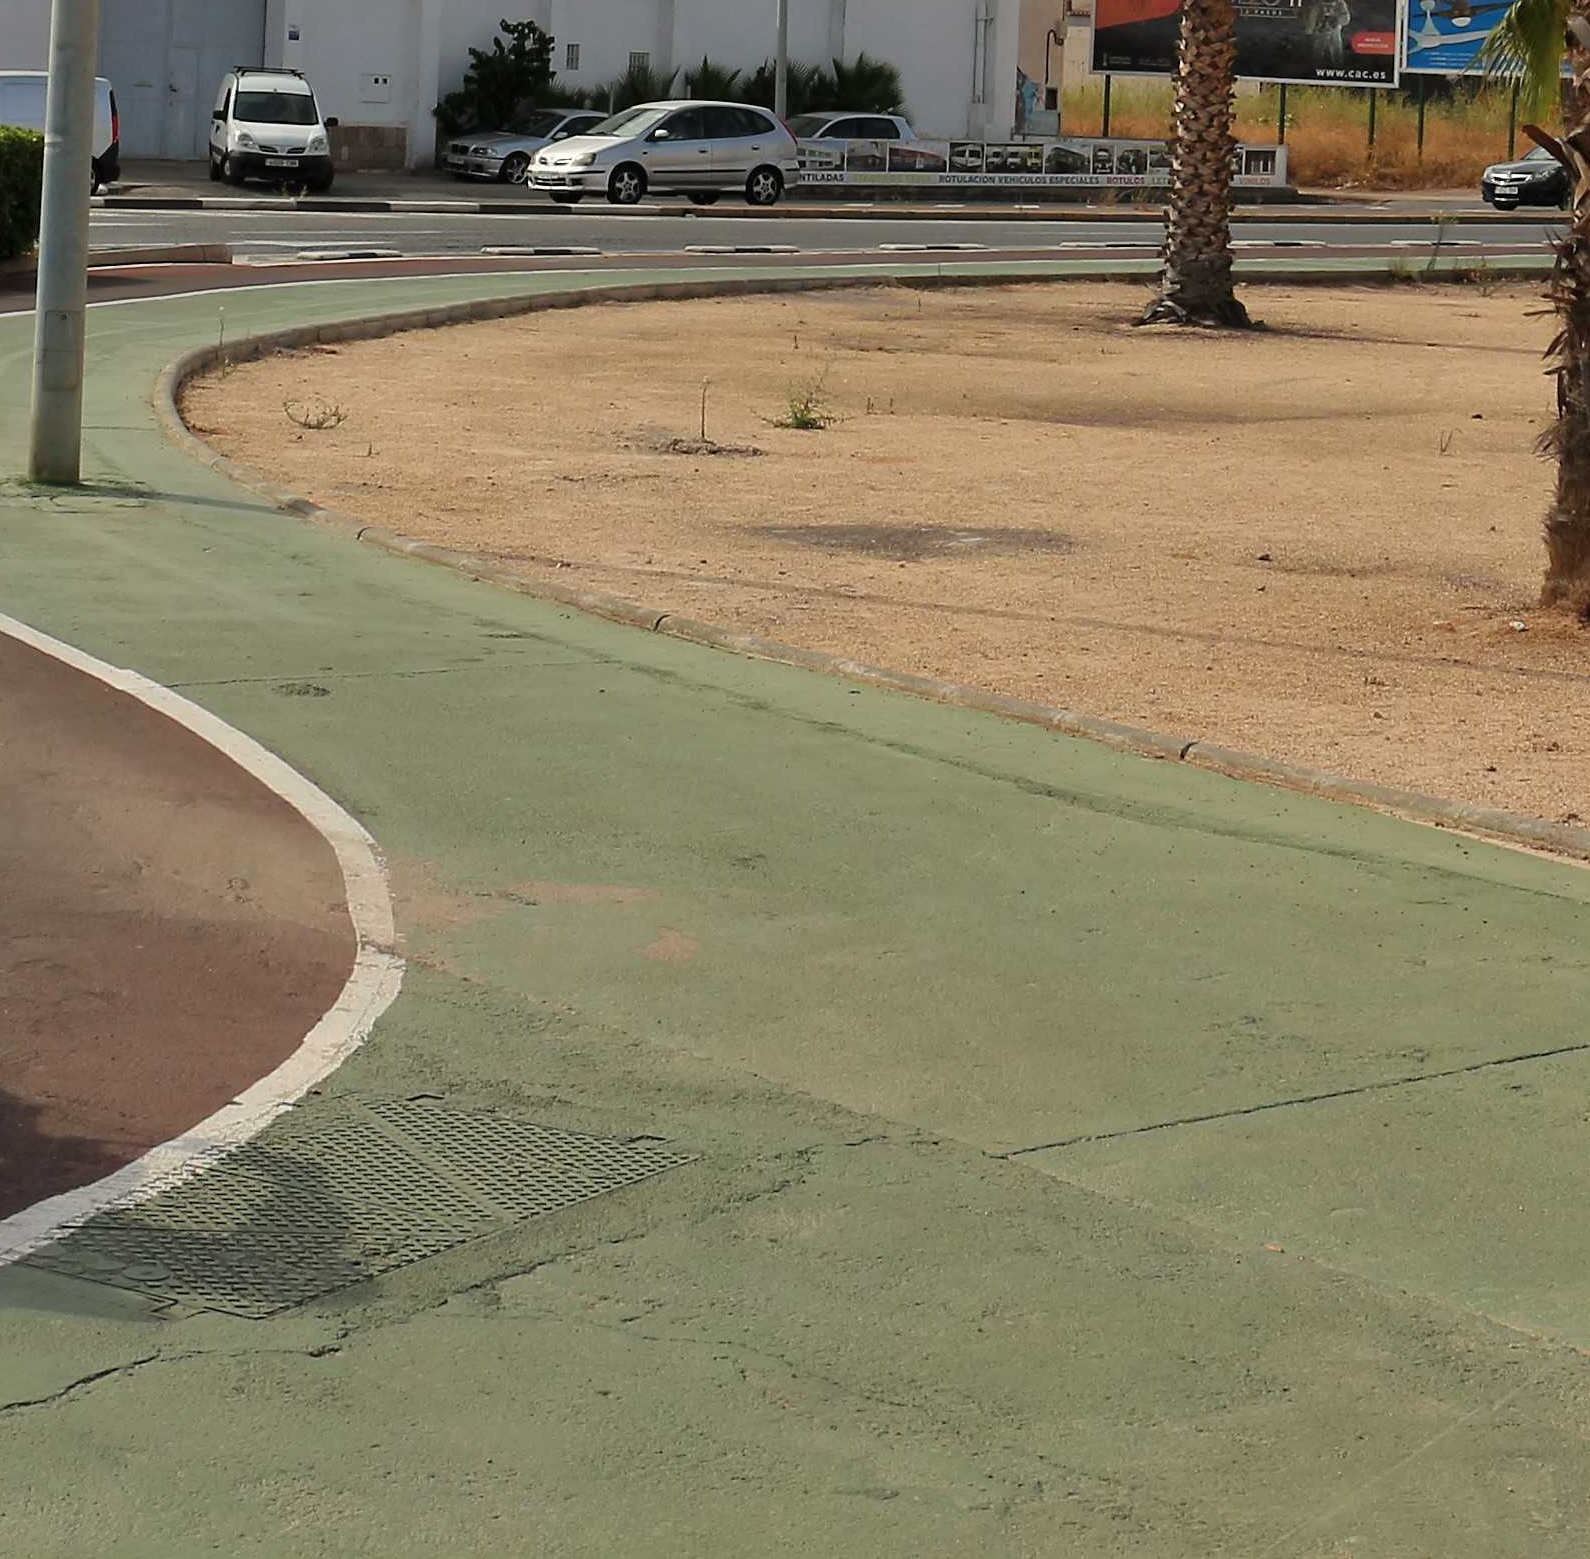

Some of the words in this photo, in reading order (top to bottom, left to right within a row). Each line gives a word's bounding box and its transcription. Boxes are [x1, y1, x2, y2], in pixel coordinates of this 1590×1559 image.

[1315, 68, 1386, 79] www.cac.es
[799, 173, 845, 183] NTILADAS
[1049, 176, 1099, 185] ESPECIALES
